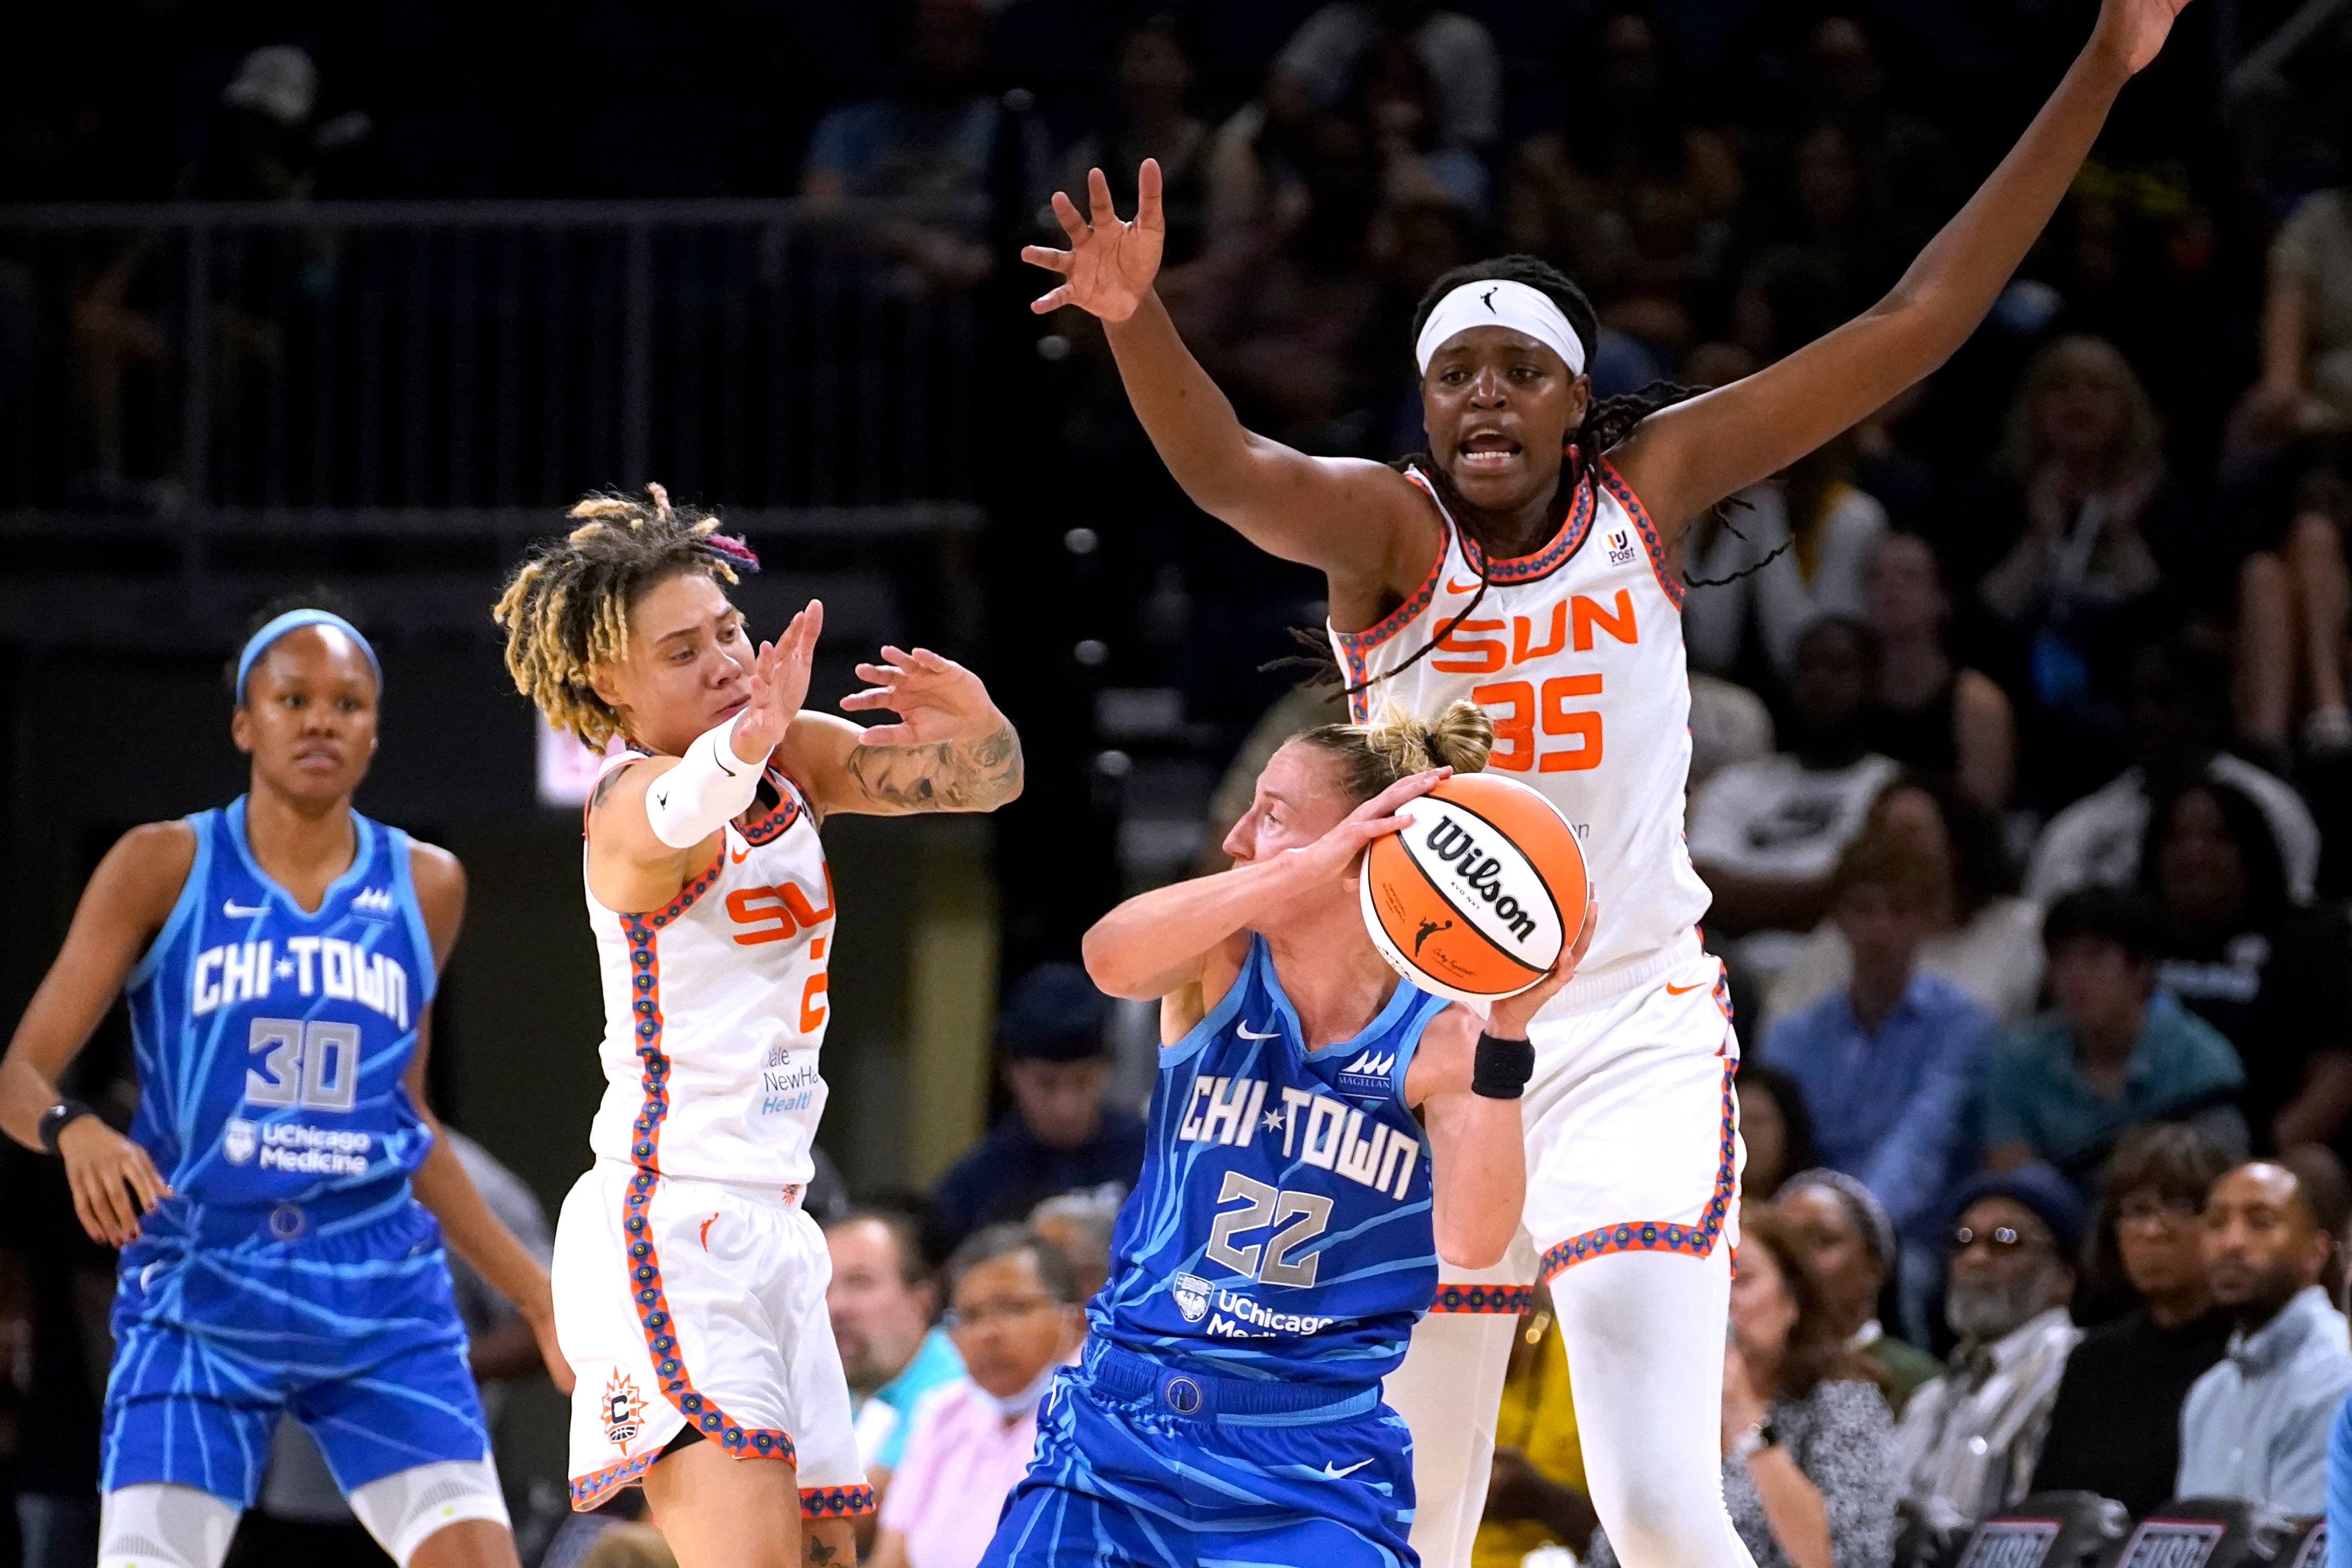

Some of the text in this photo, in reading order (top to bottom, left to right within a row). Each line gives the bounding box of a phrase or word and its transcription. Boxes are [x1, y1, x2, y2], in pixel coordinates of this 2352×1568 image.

[1608, 547, 1634, 562] Post
[1431, 589, 1638, 673] SUN
[1471, 674, 1603, 773] 35
[1425, 814, 1537, 944] Wilson
[1466, 896, 1480, 910] NXT
[245, 1017, 361, 1113] 30
[1338, 1077, 1390, 1088] MAGELLAN
[260, 1146, 369, 1176] Medicine
[263, 1123, 371, 1152] UChicago
[1205, 1170, 1334, 1288] 22
